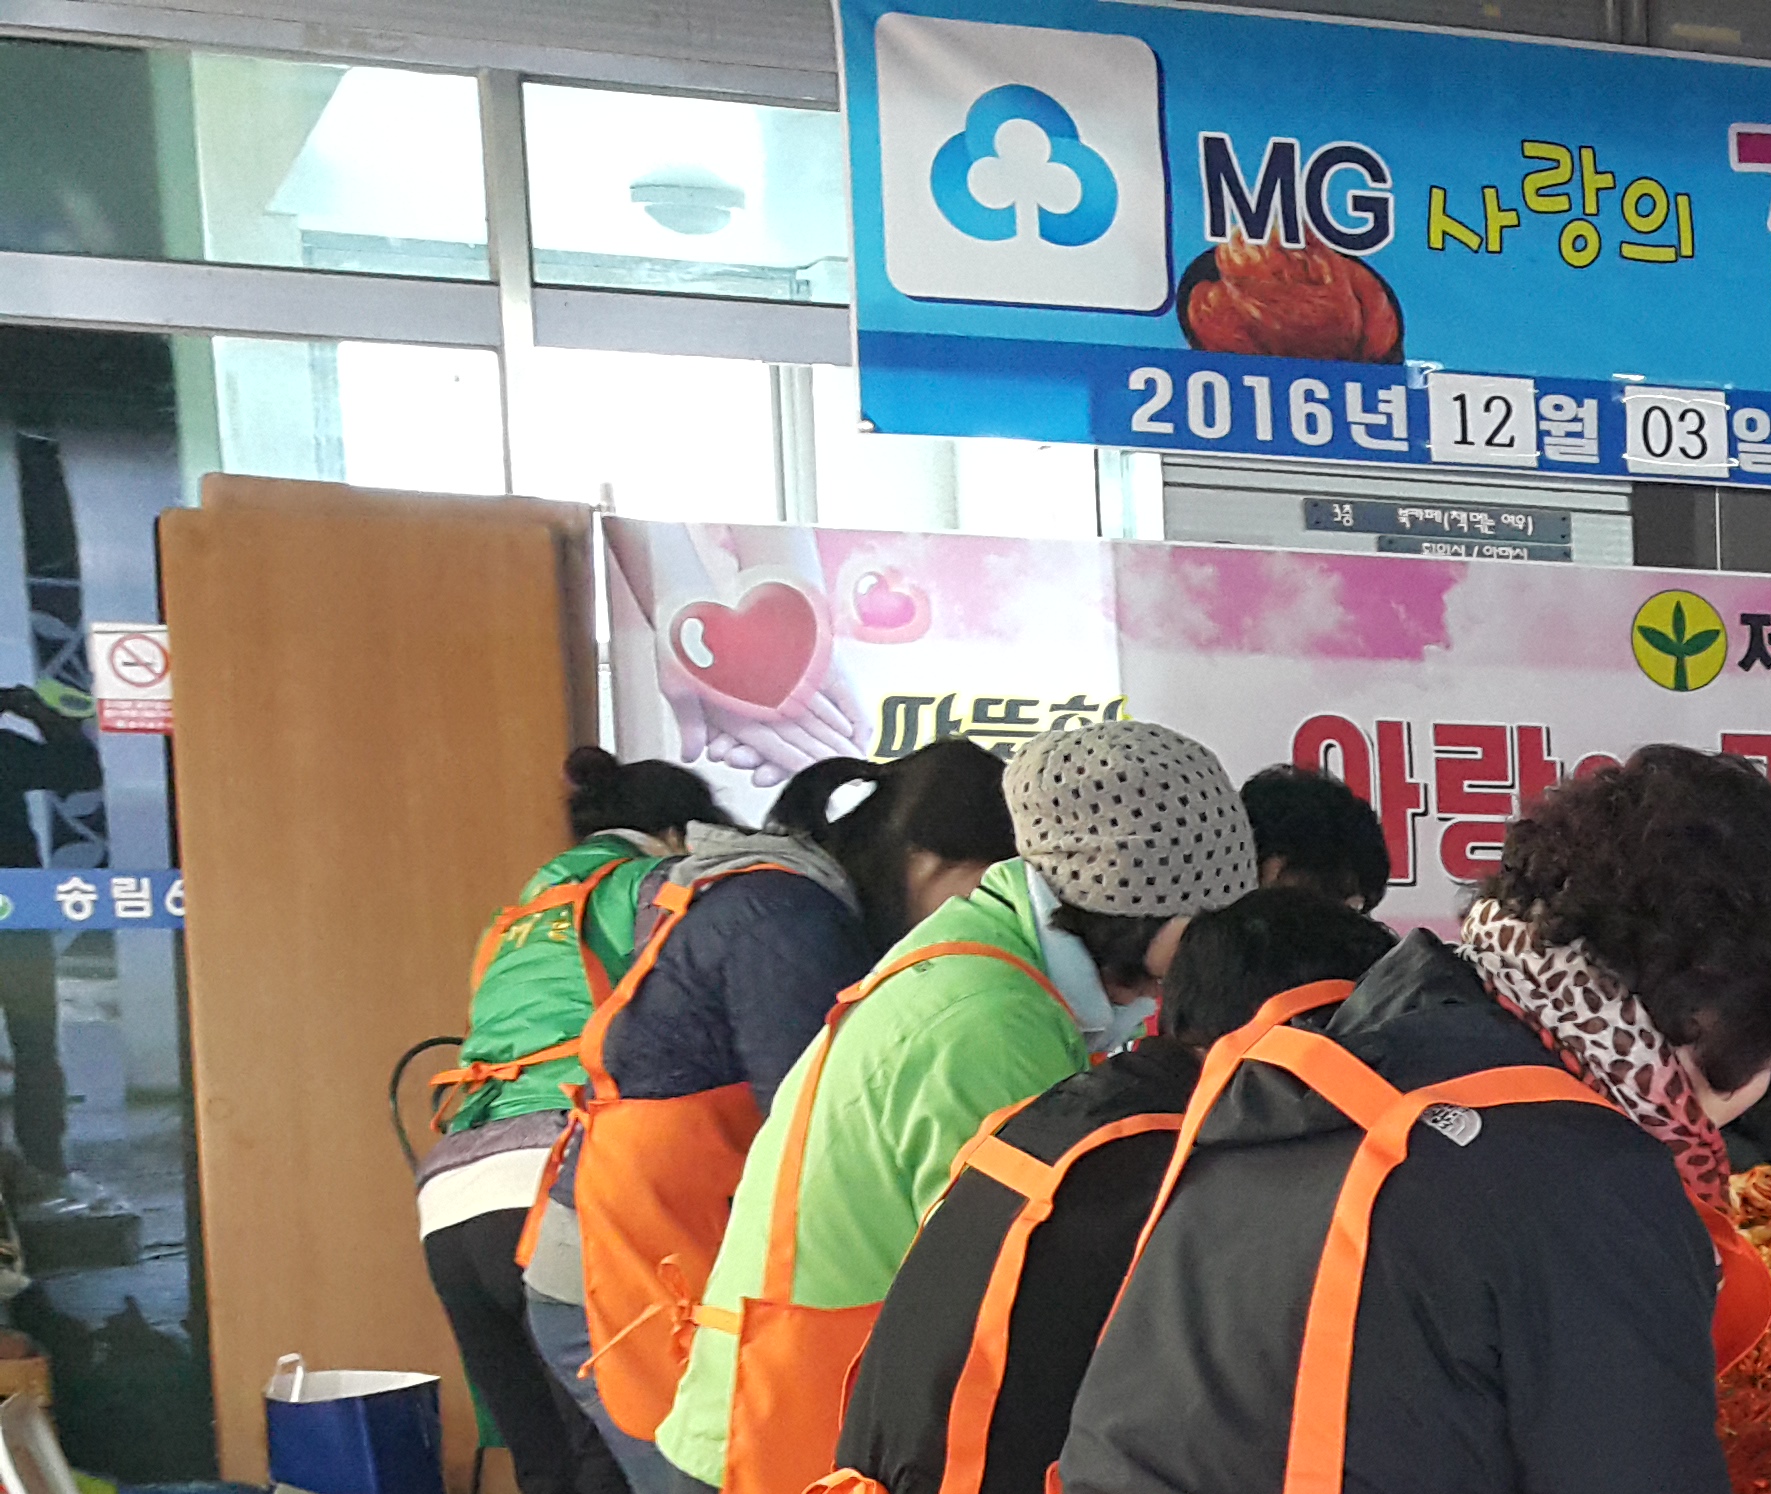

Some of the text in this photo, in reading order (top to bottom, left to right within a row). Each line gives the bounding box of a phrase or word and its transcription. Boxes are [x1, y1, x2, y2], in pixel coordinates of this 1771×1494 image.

[1200, 132, 1395, 254] MG
[1427, 139, 1694, 268] 사랑의
[1128, 366, 1409, 453] 2016년
[1451, 393, 1600, 465] 12월
